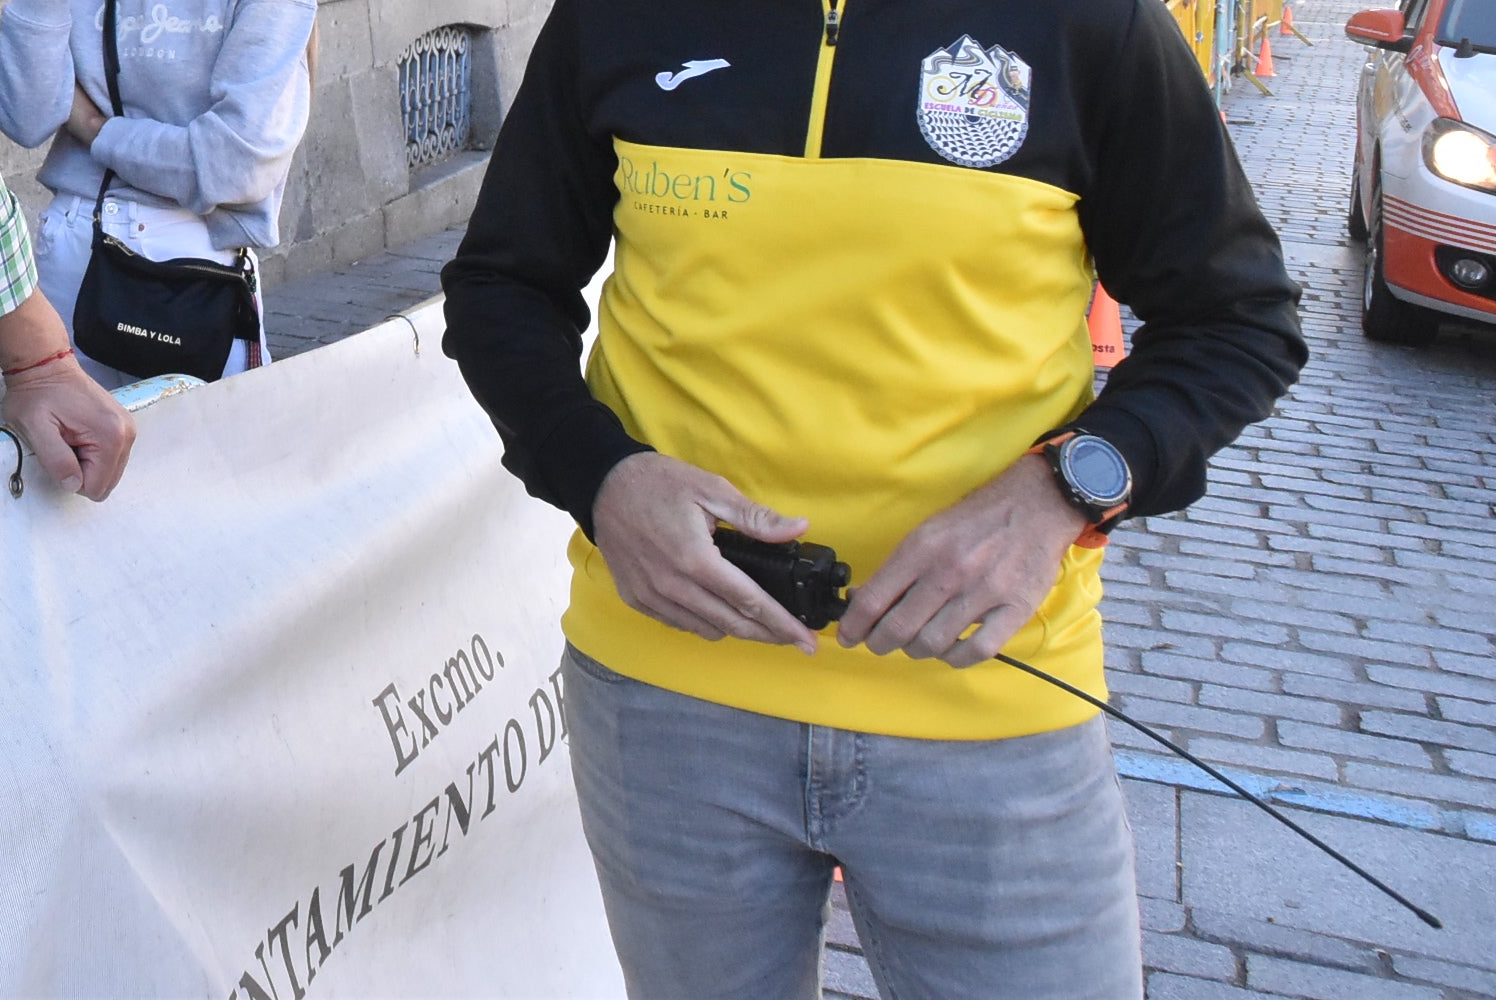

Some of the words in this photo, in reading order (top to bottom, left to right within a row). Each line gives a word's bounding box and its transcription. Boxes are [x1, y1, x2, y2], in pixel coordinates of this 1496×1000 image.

[924, 103, 962, 113] ESCUELA
[634, 201, 689, 217] CAFETERÍA
[704, 209, 728, 219] BAR
[117, 322, 147, 338] BIMBA
[150, 331, 156, 339] Y
[157, 333, 181, 346] LOLA
[372, 633, 505, 777] Excmo.
[229, 718, 527, 1000] NTAMIENTO
